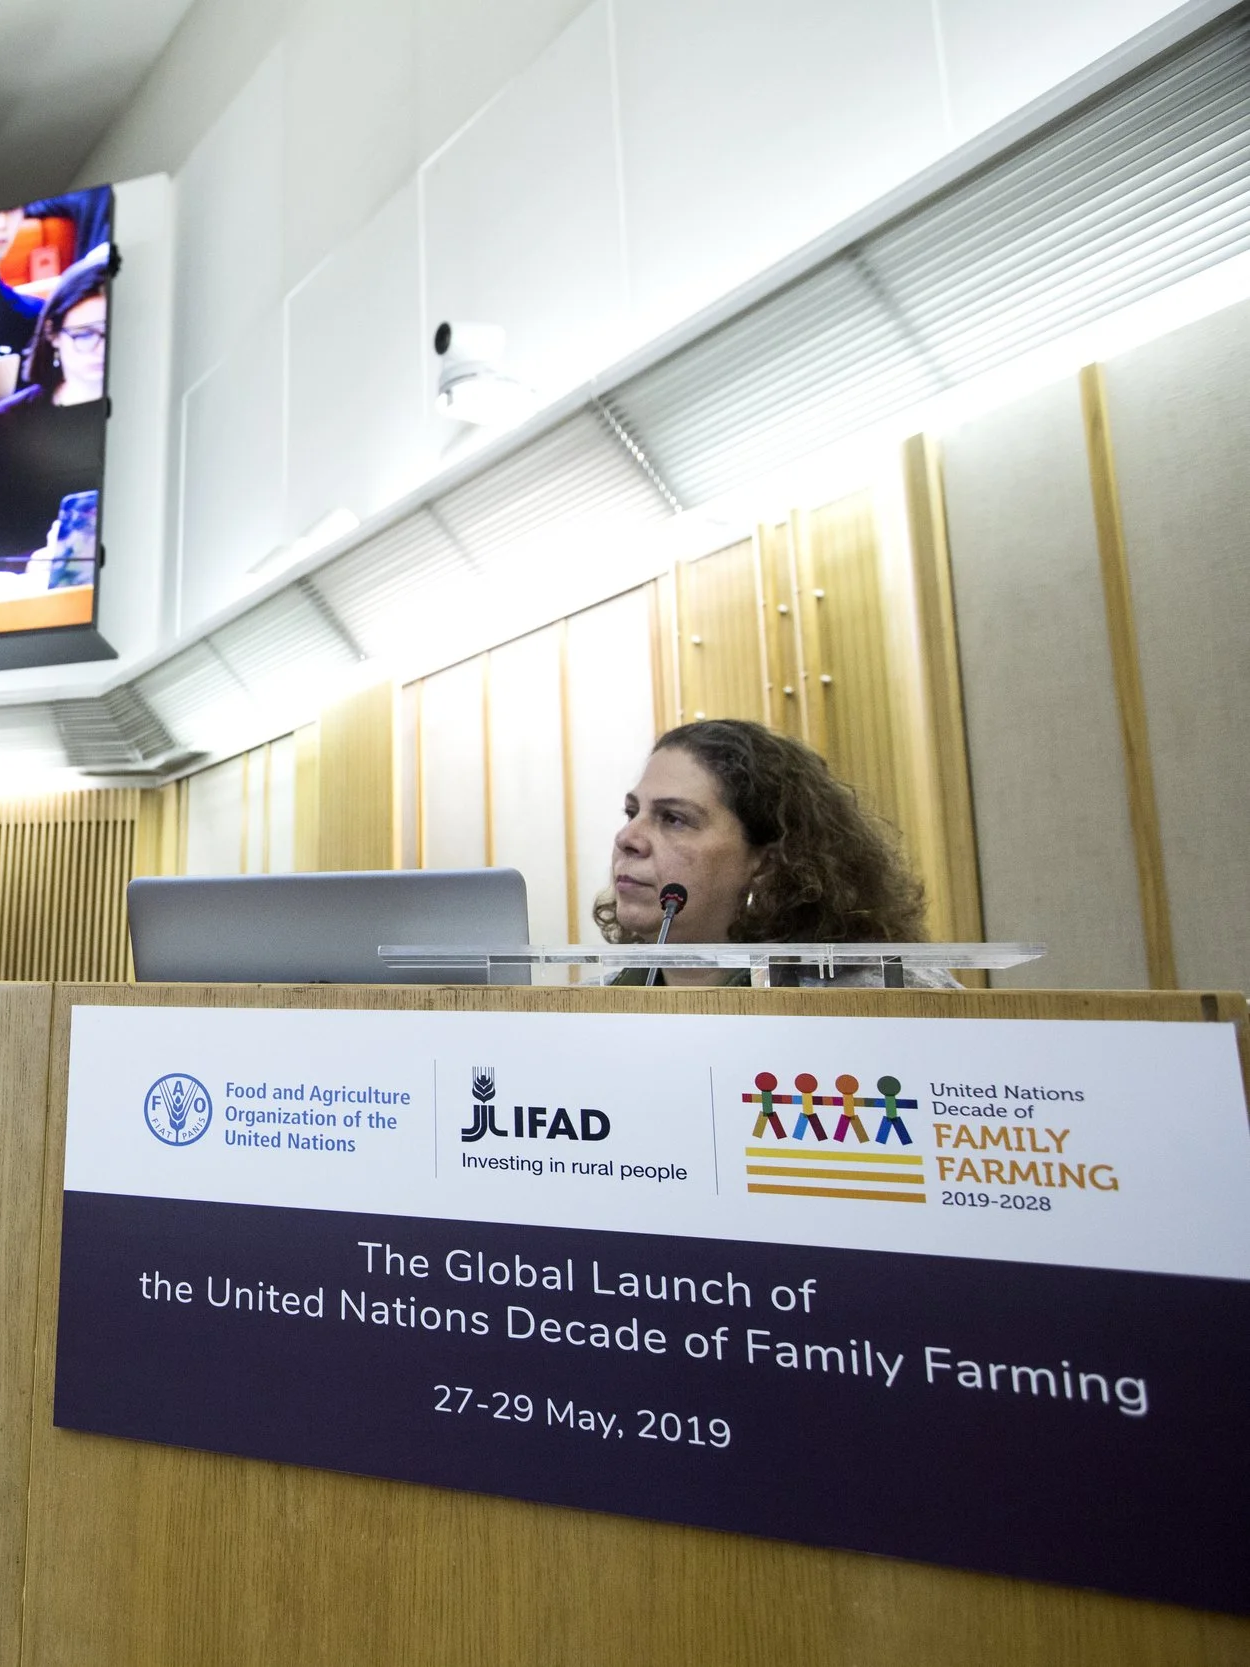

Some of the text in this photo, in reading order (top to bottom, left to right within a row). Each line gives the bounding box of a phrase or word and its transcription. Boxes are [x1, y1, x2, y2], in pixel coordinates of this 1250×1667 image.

[151, 1080, 207, 1114] FAO
[226, 1082, 411, 1106] Food and Agriculture
[930, 1083, 1085, 1102] United Nations
[225, 1106, 398, 1130] Organization of the
[513, 1105, 611, 1142] IFAD
[932, 1101, 1035, 1119] Decade of
[151, 1116, 206, 1141] FIAT PANIS
[225, 1130, 356, 1152] United Nations
[933, 1123, 1070, 1154] FAMILY
[461, 1152, 688, 1183] Investing in rural people
[936, 1156, 1119, 1191] FARMING
[941, 1190, 1051, 1212] 2019-2028
[357, 1241, 817, 1313] The Global Launch of
[138, 1270, 1148, 1416] the United Nations Decade of Family Farming
[433, 1384, 731, 1448] 27-29 May, 2019
